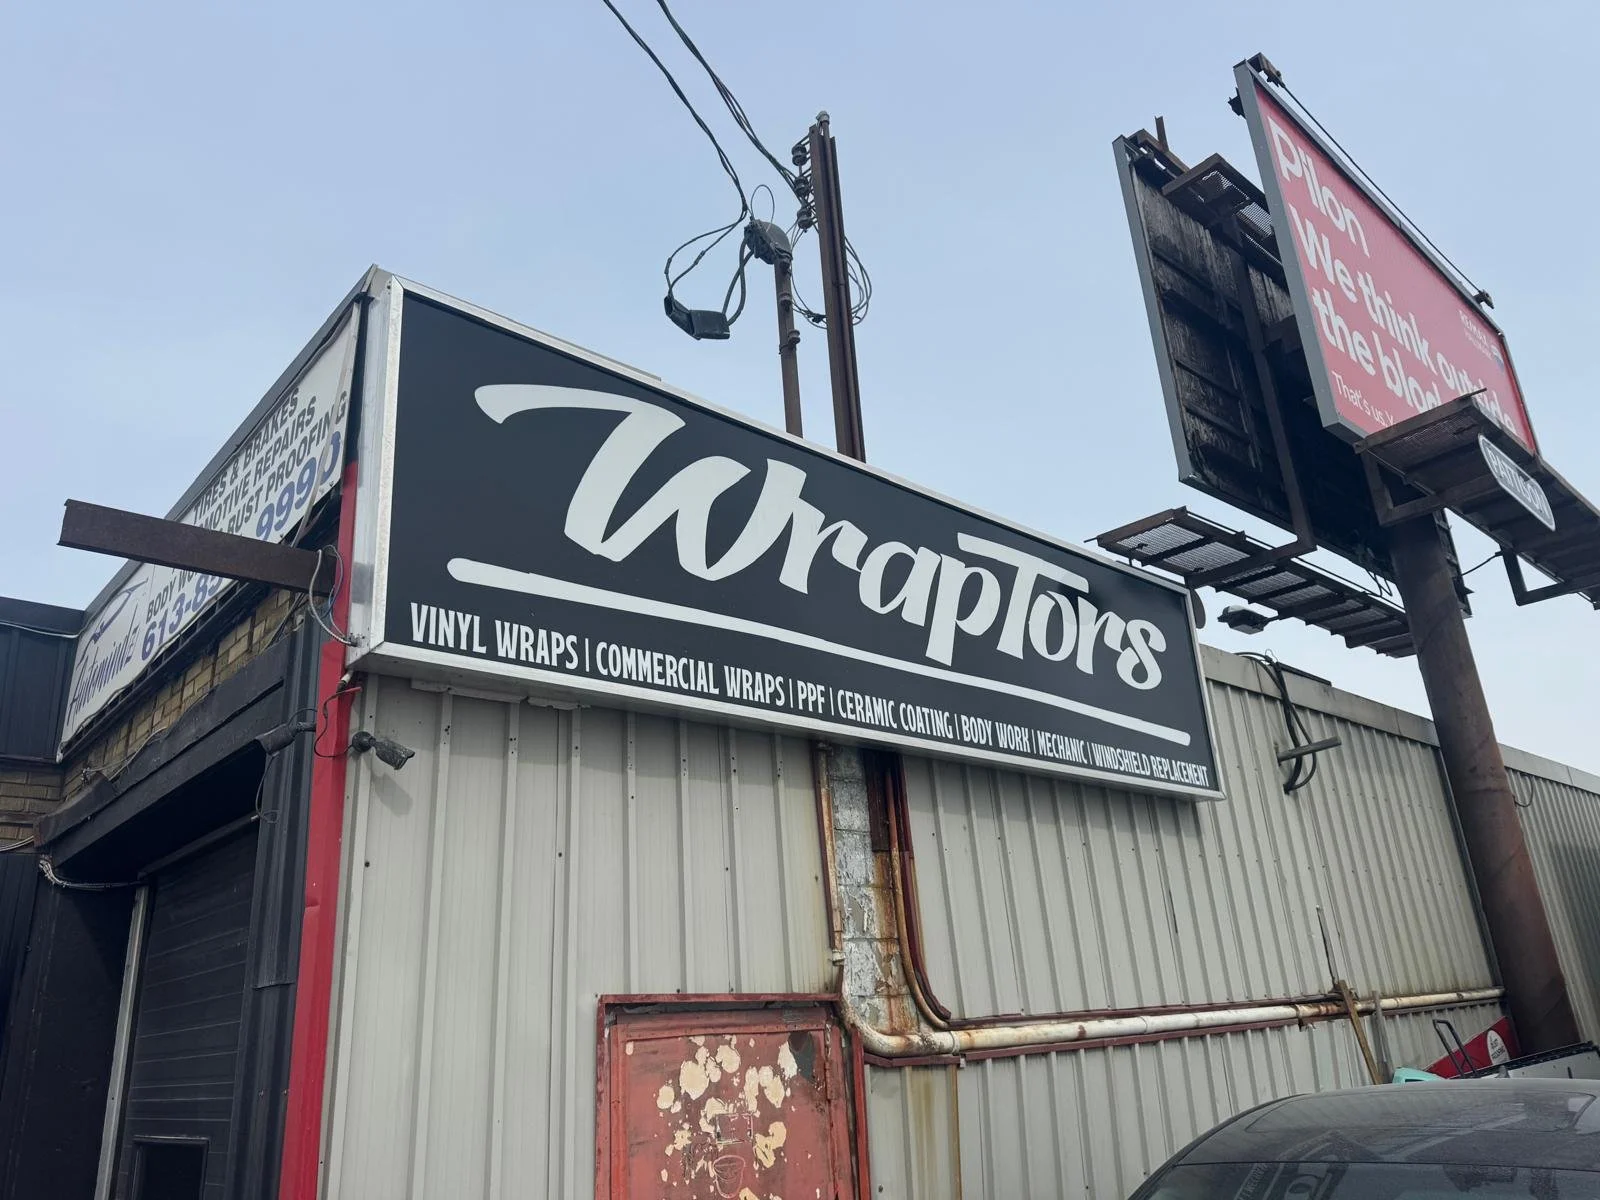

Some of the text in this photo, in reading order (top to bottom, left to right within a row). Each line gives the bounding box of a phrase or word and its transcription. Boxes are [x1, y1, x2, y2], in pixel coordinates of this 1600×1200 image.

[1267, 115, 1370, 258] Pilon
[1288, 203, 1359, 304] We
[1356, 271, 1439, 377] think
[1311, 287, 1376, 377] the
[193, 387, 300, 525] TIRES & BRAKES
[252, 395, 317, 487] REPAIRS
[1331, 370, 1371, 416] That's
[146, 576, 177, 625] BODY
[227, 485, 264, 535] RUST
[264, 390, 348, 503] PROOFING
[410, 602, 1210, 788] VINYL WRAPS COMMERCIAL WRAPS PPF CERAMIC COATING BODY WORK MECHANIC WINDSHIELD REPLACEMENT
